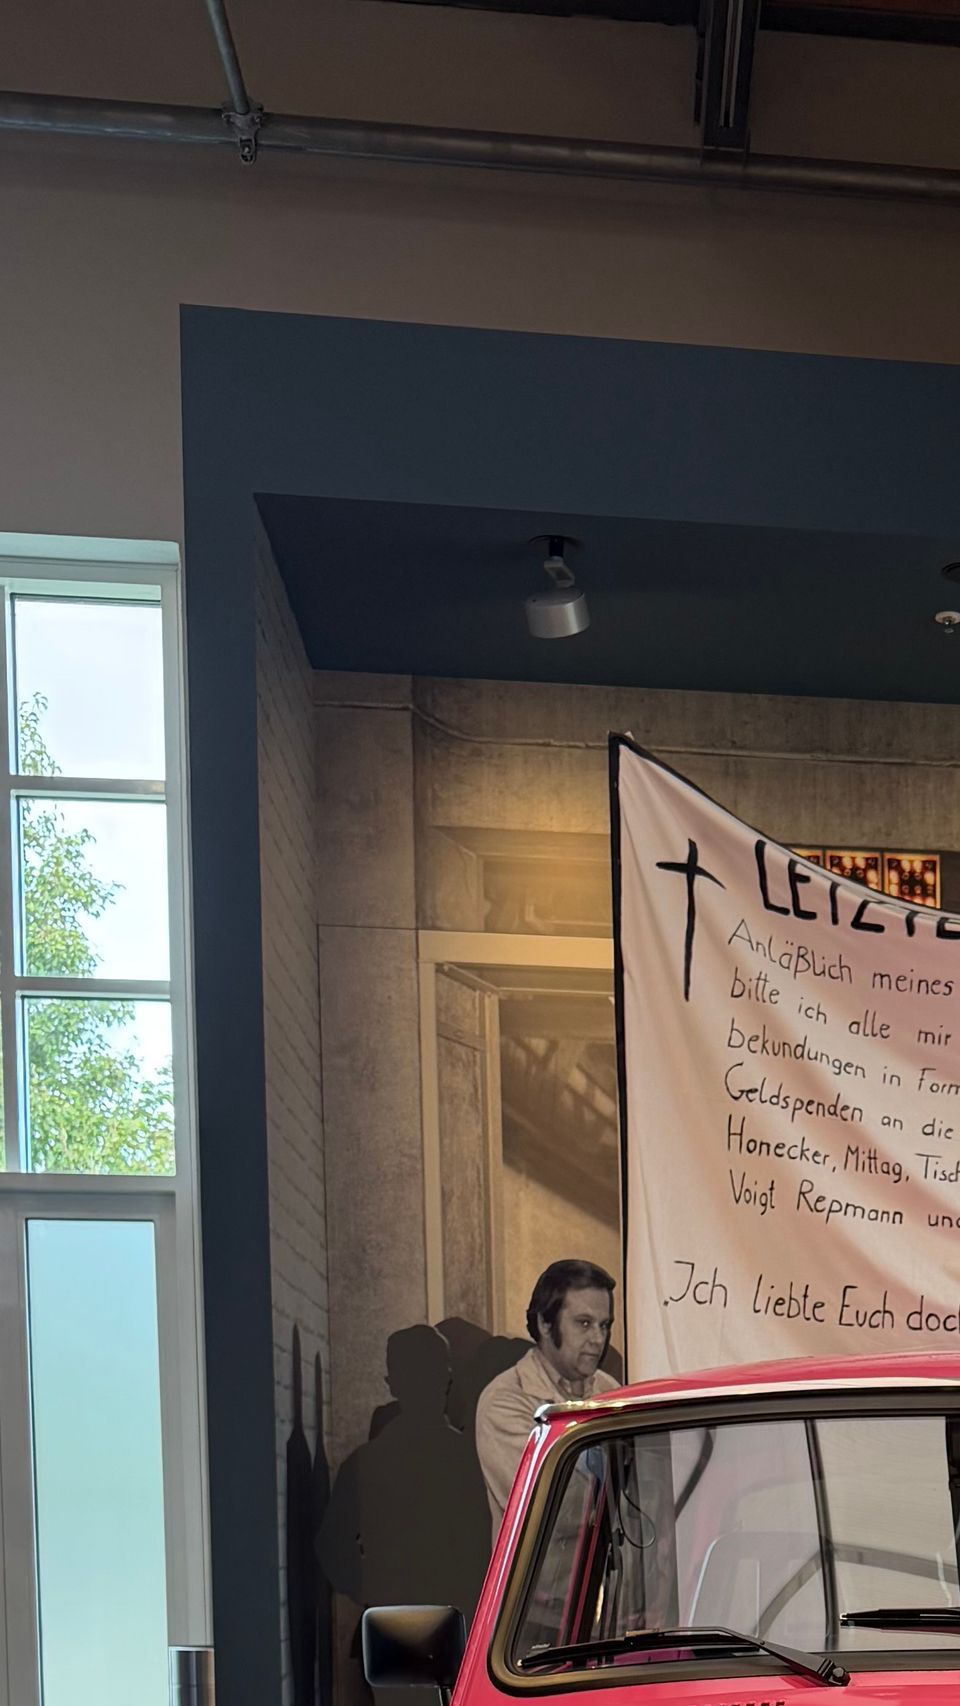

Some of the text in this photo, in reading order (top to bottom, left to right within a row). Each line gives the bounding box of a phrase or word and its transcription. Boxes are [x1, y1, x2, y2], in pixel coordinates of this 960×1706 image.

[727, 918, 853, 984] Anläßlich
[871, 968, 954, 997] meines
[730, 966, 781, 1004] bitte
[797, 996, 828, 1025] ich
[848, 1008, 891, 1040] alle
[917, 1025, 952, 1047] mir
[727, 1016, 866, 1080] bekundungen
[882, 1066, 901, 1087] in
[724, 1062, 863, 1123] Geldspenden
[881, 1114, 904, 1131] an
[921, 1117, 954, 1140] die
[727, 1114, 837, 1173] Honecker,
[844, 1144, 911, 1183] Mittag,
[729, 1168, 776, 1216] Voigt
[796, 1178, 904, 1225] Repmann
[752, 1273, 826, 1323] liebte
[838, 1285, 895, 1329] Euch
